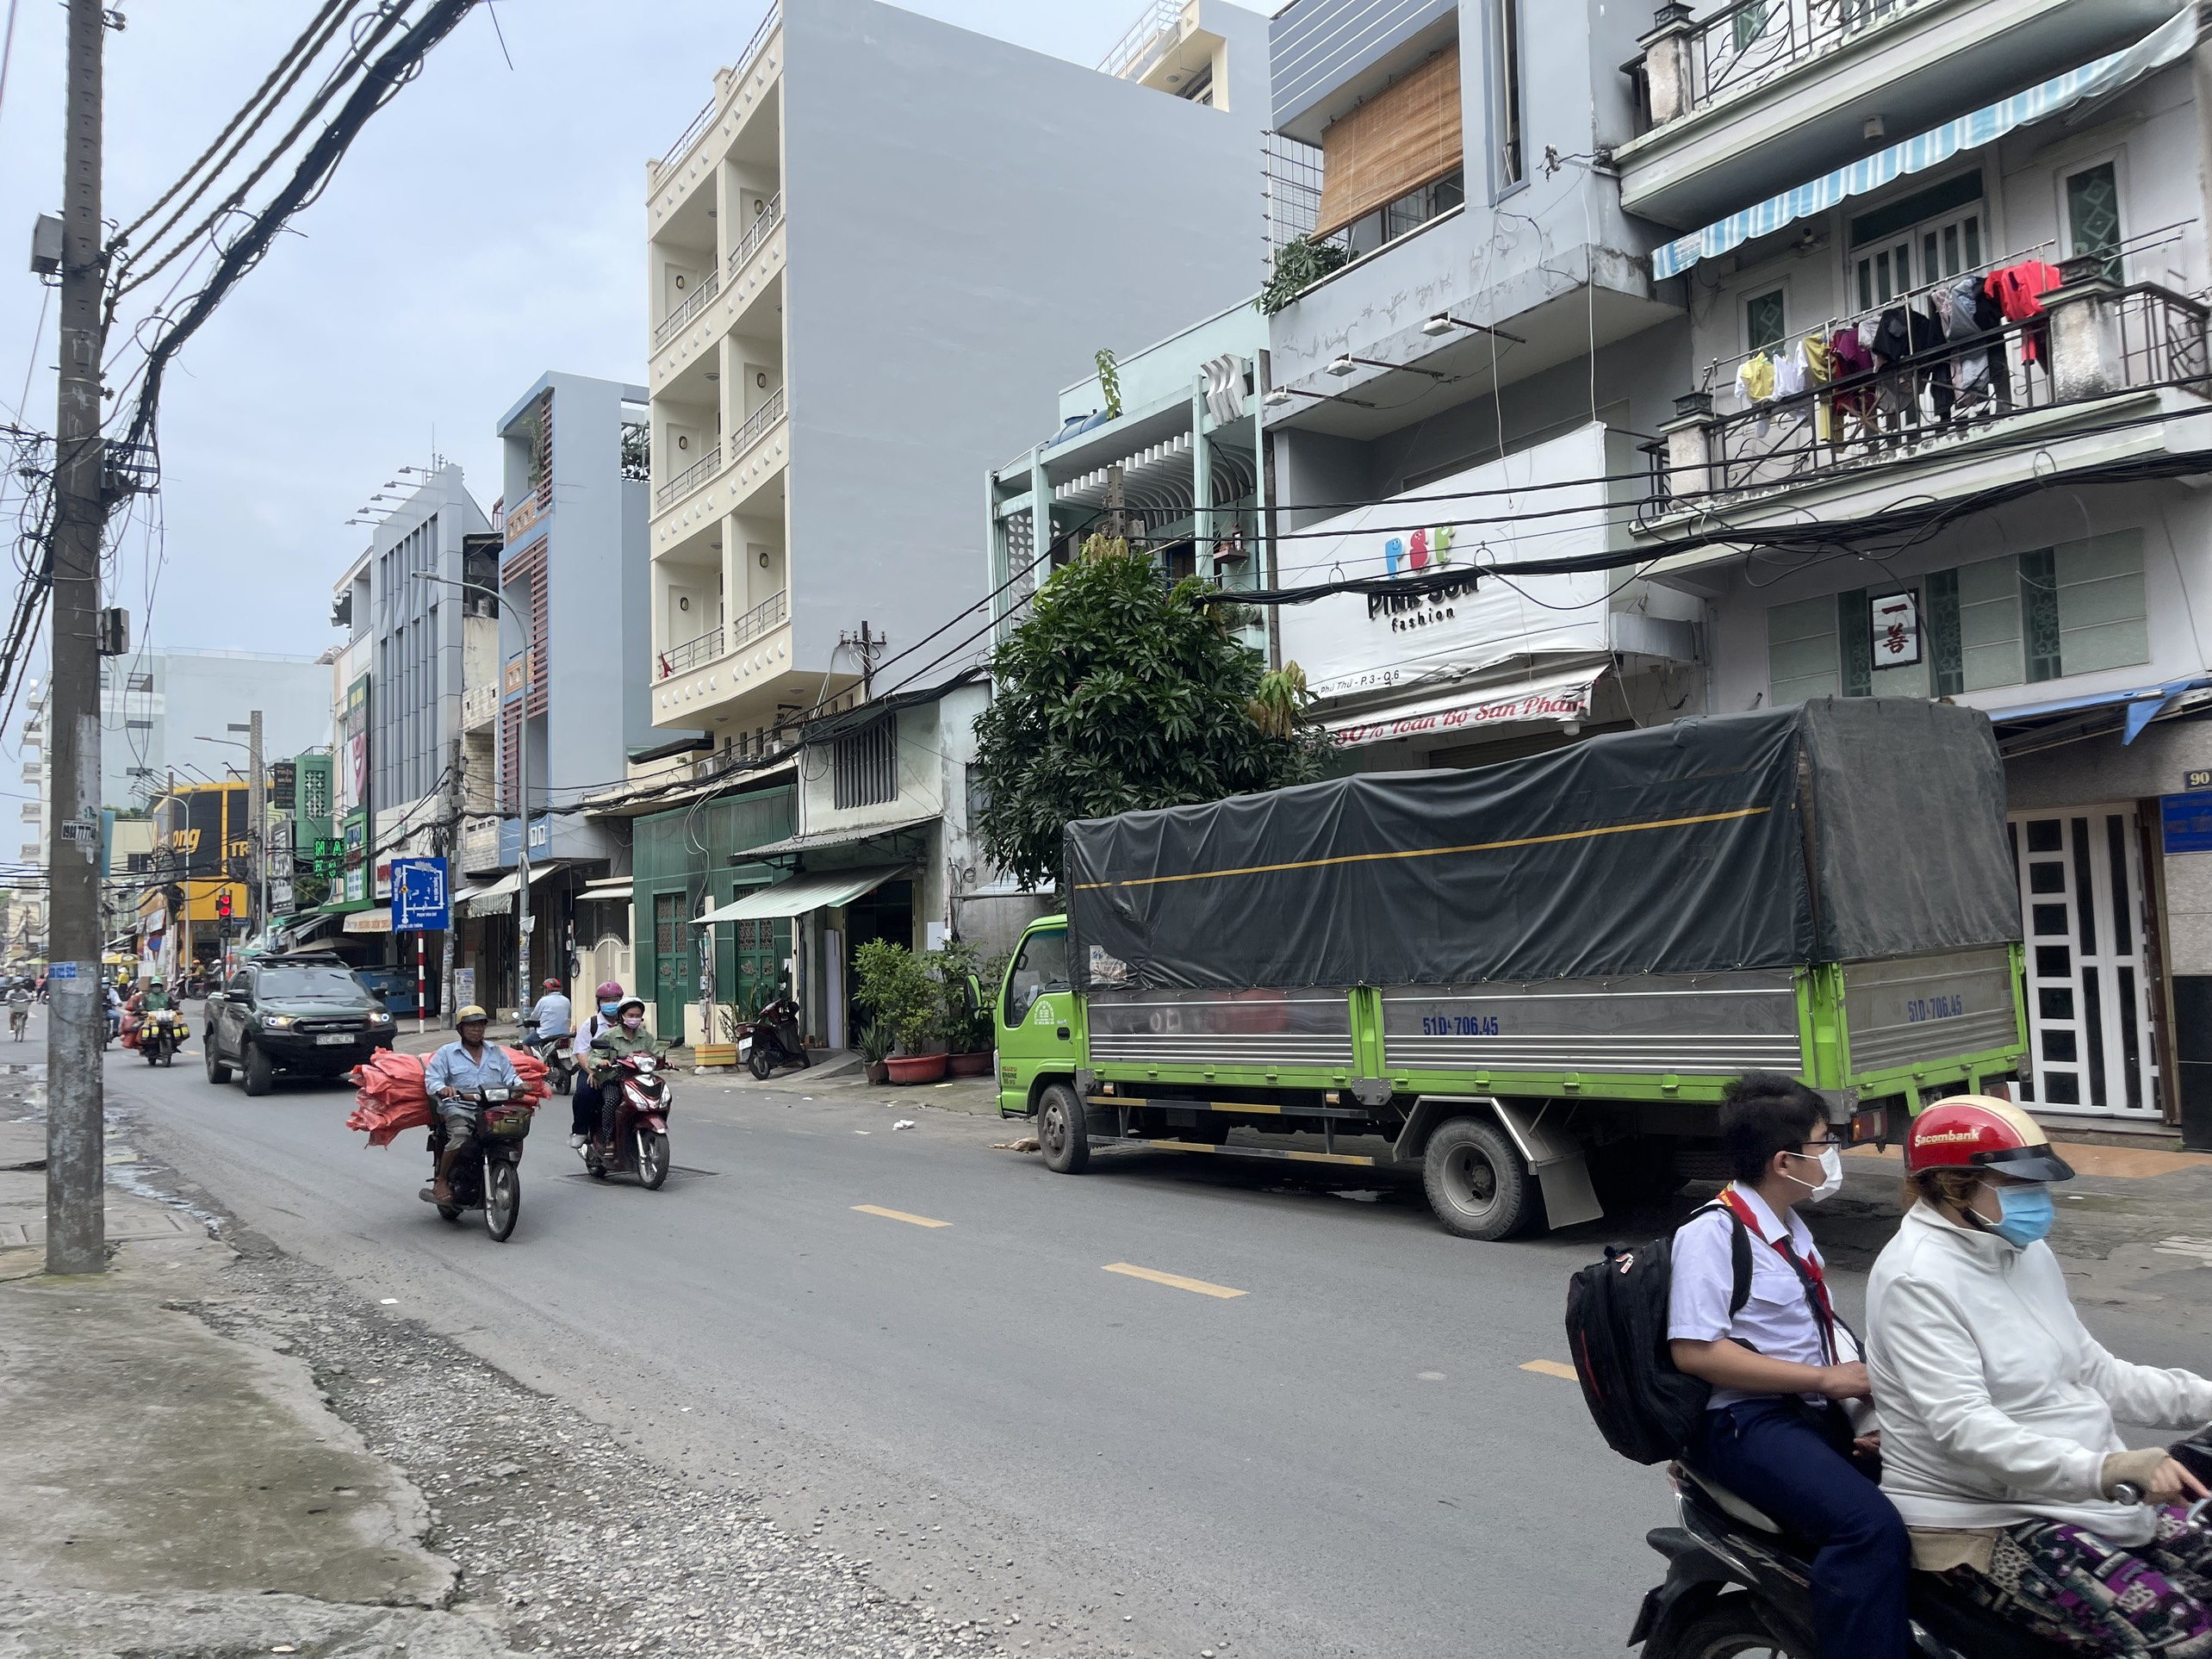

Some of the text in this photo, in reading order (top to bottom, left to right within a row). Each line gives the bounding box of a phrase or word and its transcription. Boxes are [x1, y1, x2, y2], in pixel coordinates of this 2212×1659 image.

[1391, 607, 1456, 633] fashion
[1383, 669, 1400, 682] Q.6
[2190, 771, 2210, 786] 90
[1914, 1128, 1980, 1148] Sacombank
